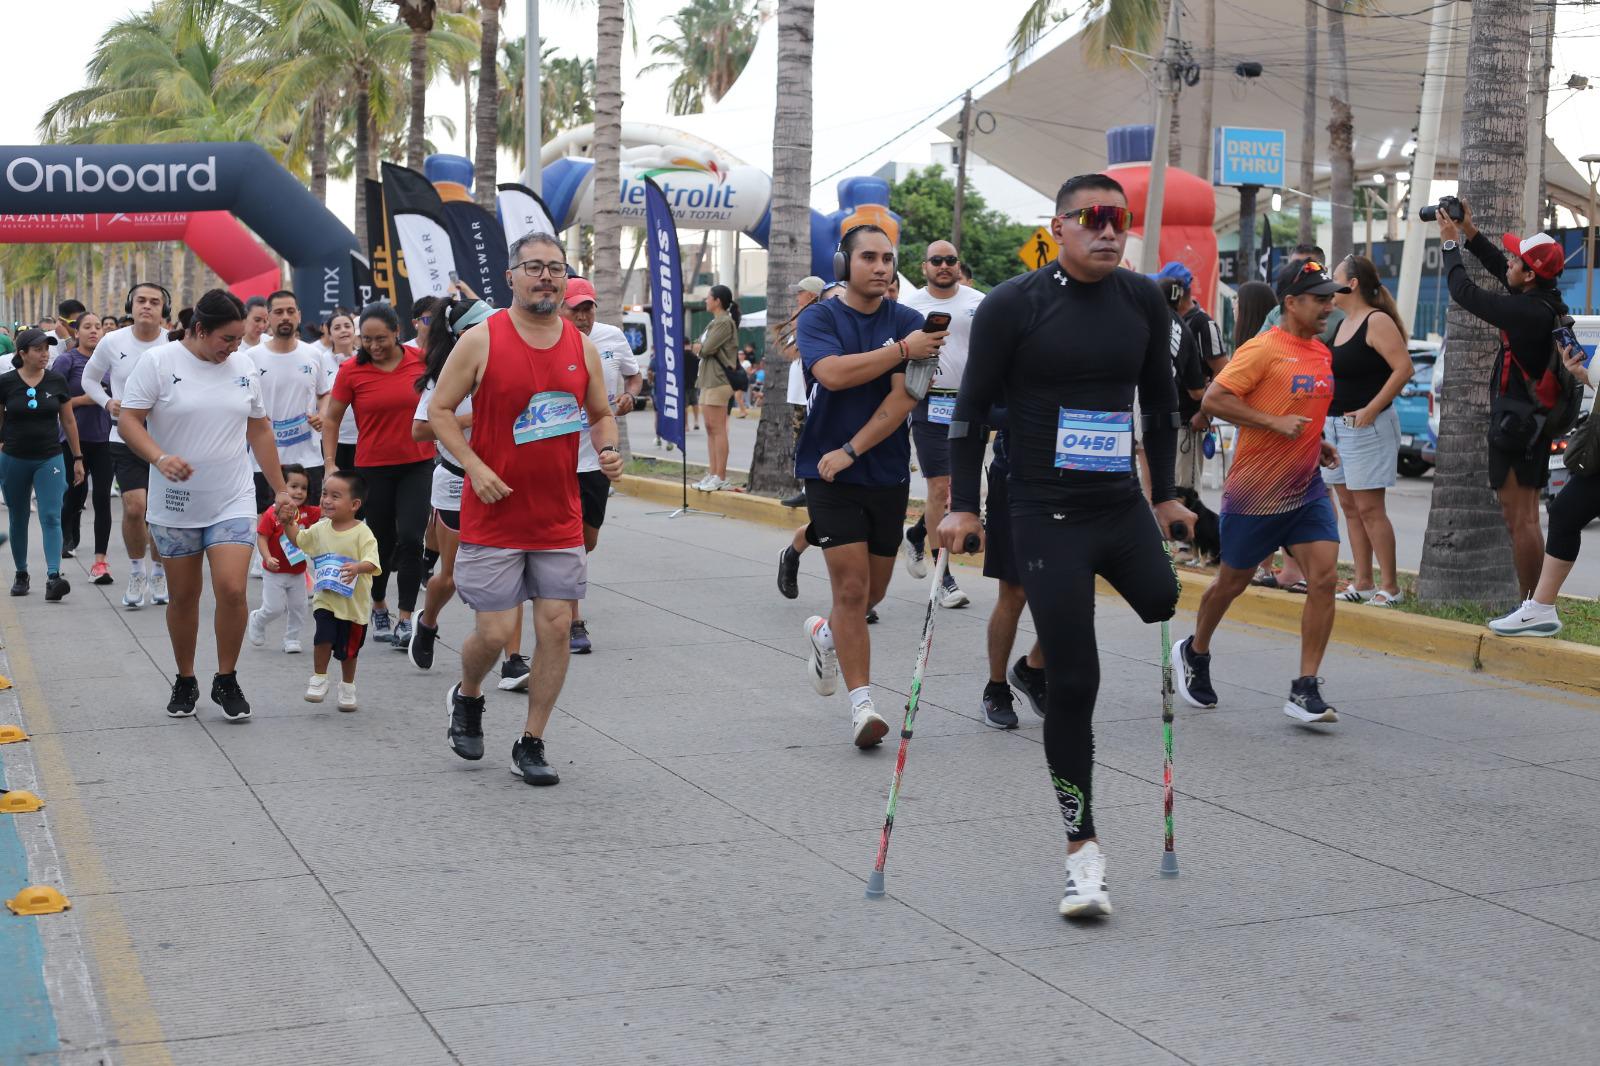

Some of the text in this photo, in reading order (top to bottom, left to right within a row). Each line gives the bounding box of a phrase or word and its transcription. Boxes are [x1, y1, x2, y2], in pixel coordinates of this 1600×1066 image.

[1227, 140, 1281, 157] DRIVE
[1230, 156, 1280, 174] THRU
[6, 156, 216, 193] Onboard
[620, 179, 736, 208] letrolit
[689, 209, 732, 220] TOTAL!
[1062, 433, 1117, 451] 0458
